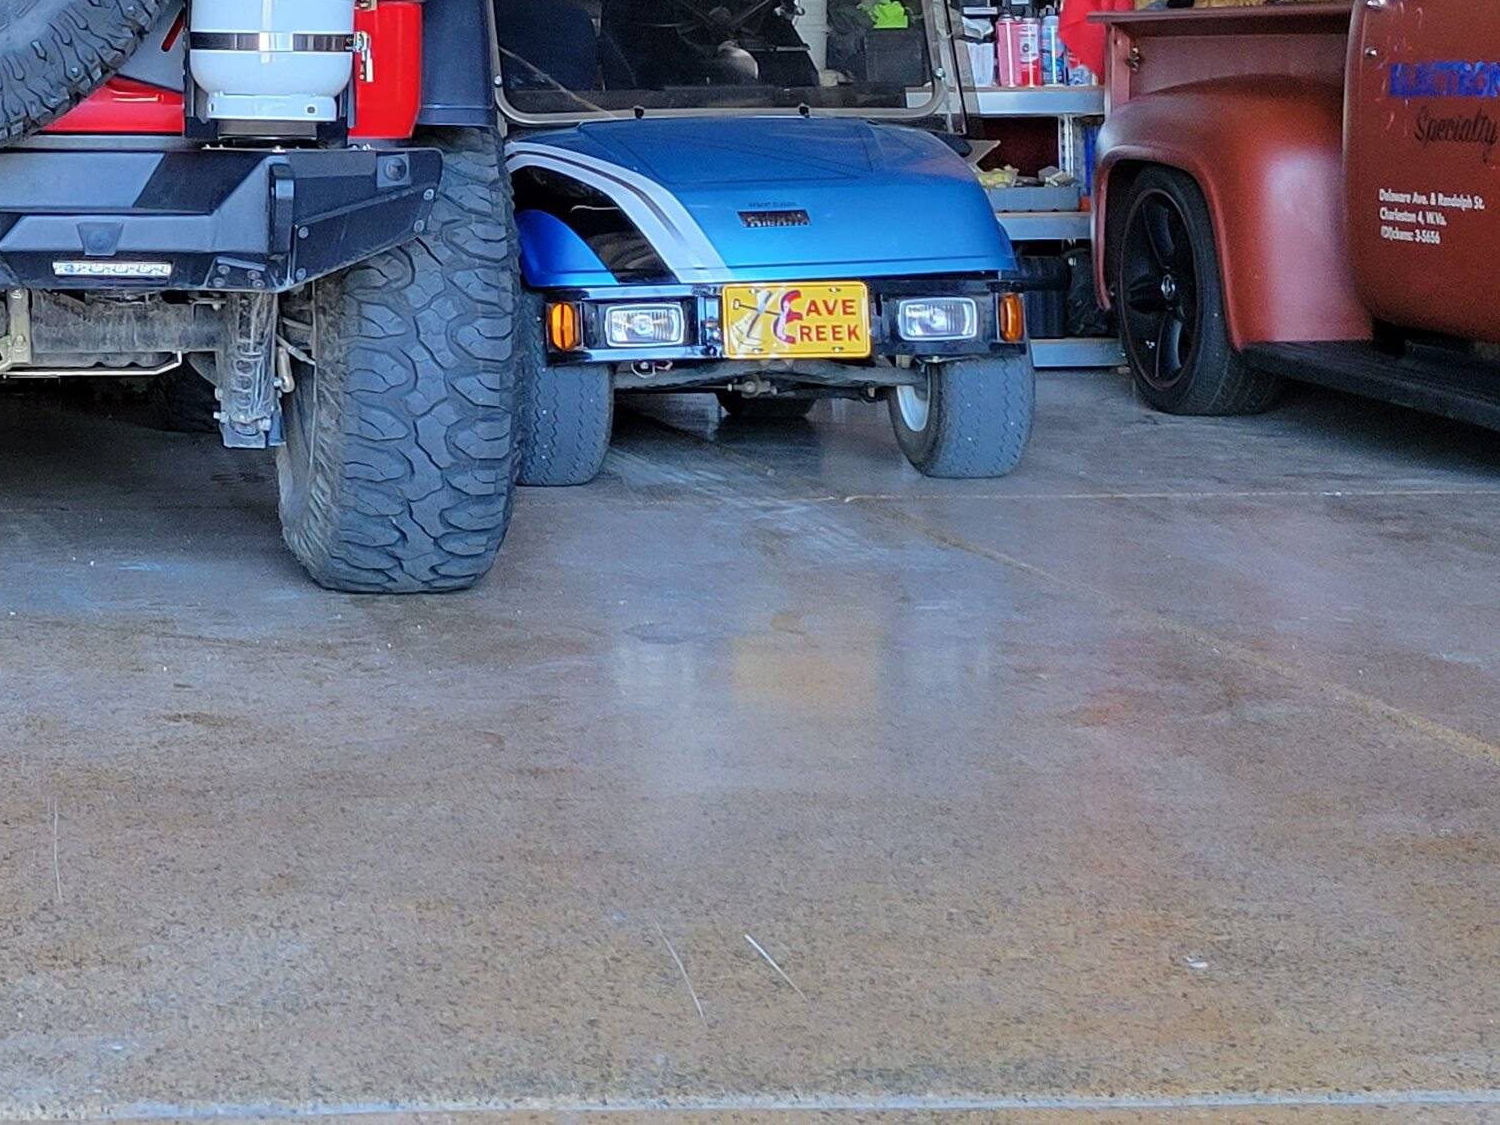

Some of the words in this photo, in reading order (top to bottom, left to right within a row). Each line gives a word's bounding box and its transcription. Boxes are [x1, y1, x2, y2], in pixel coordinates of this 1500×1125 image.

[1415, 106, 1498, 163] Specialty
[1379, 188, 1411, 204] Delaware
[1412, 191, 1428, 205] Ave.
[1438, 193, 1473, 211] Randolph
[1474, 195, 1486, 209] St.
[1379, 207, 1417, 223] Charleston
[780, 289, 857, 322] CAVE
[772, 316, 861, 345] CREEK
